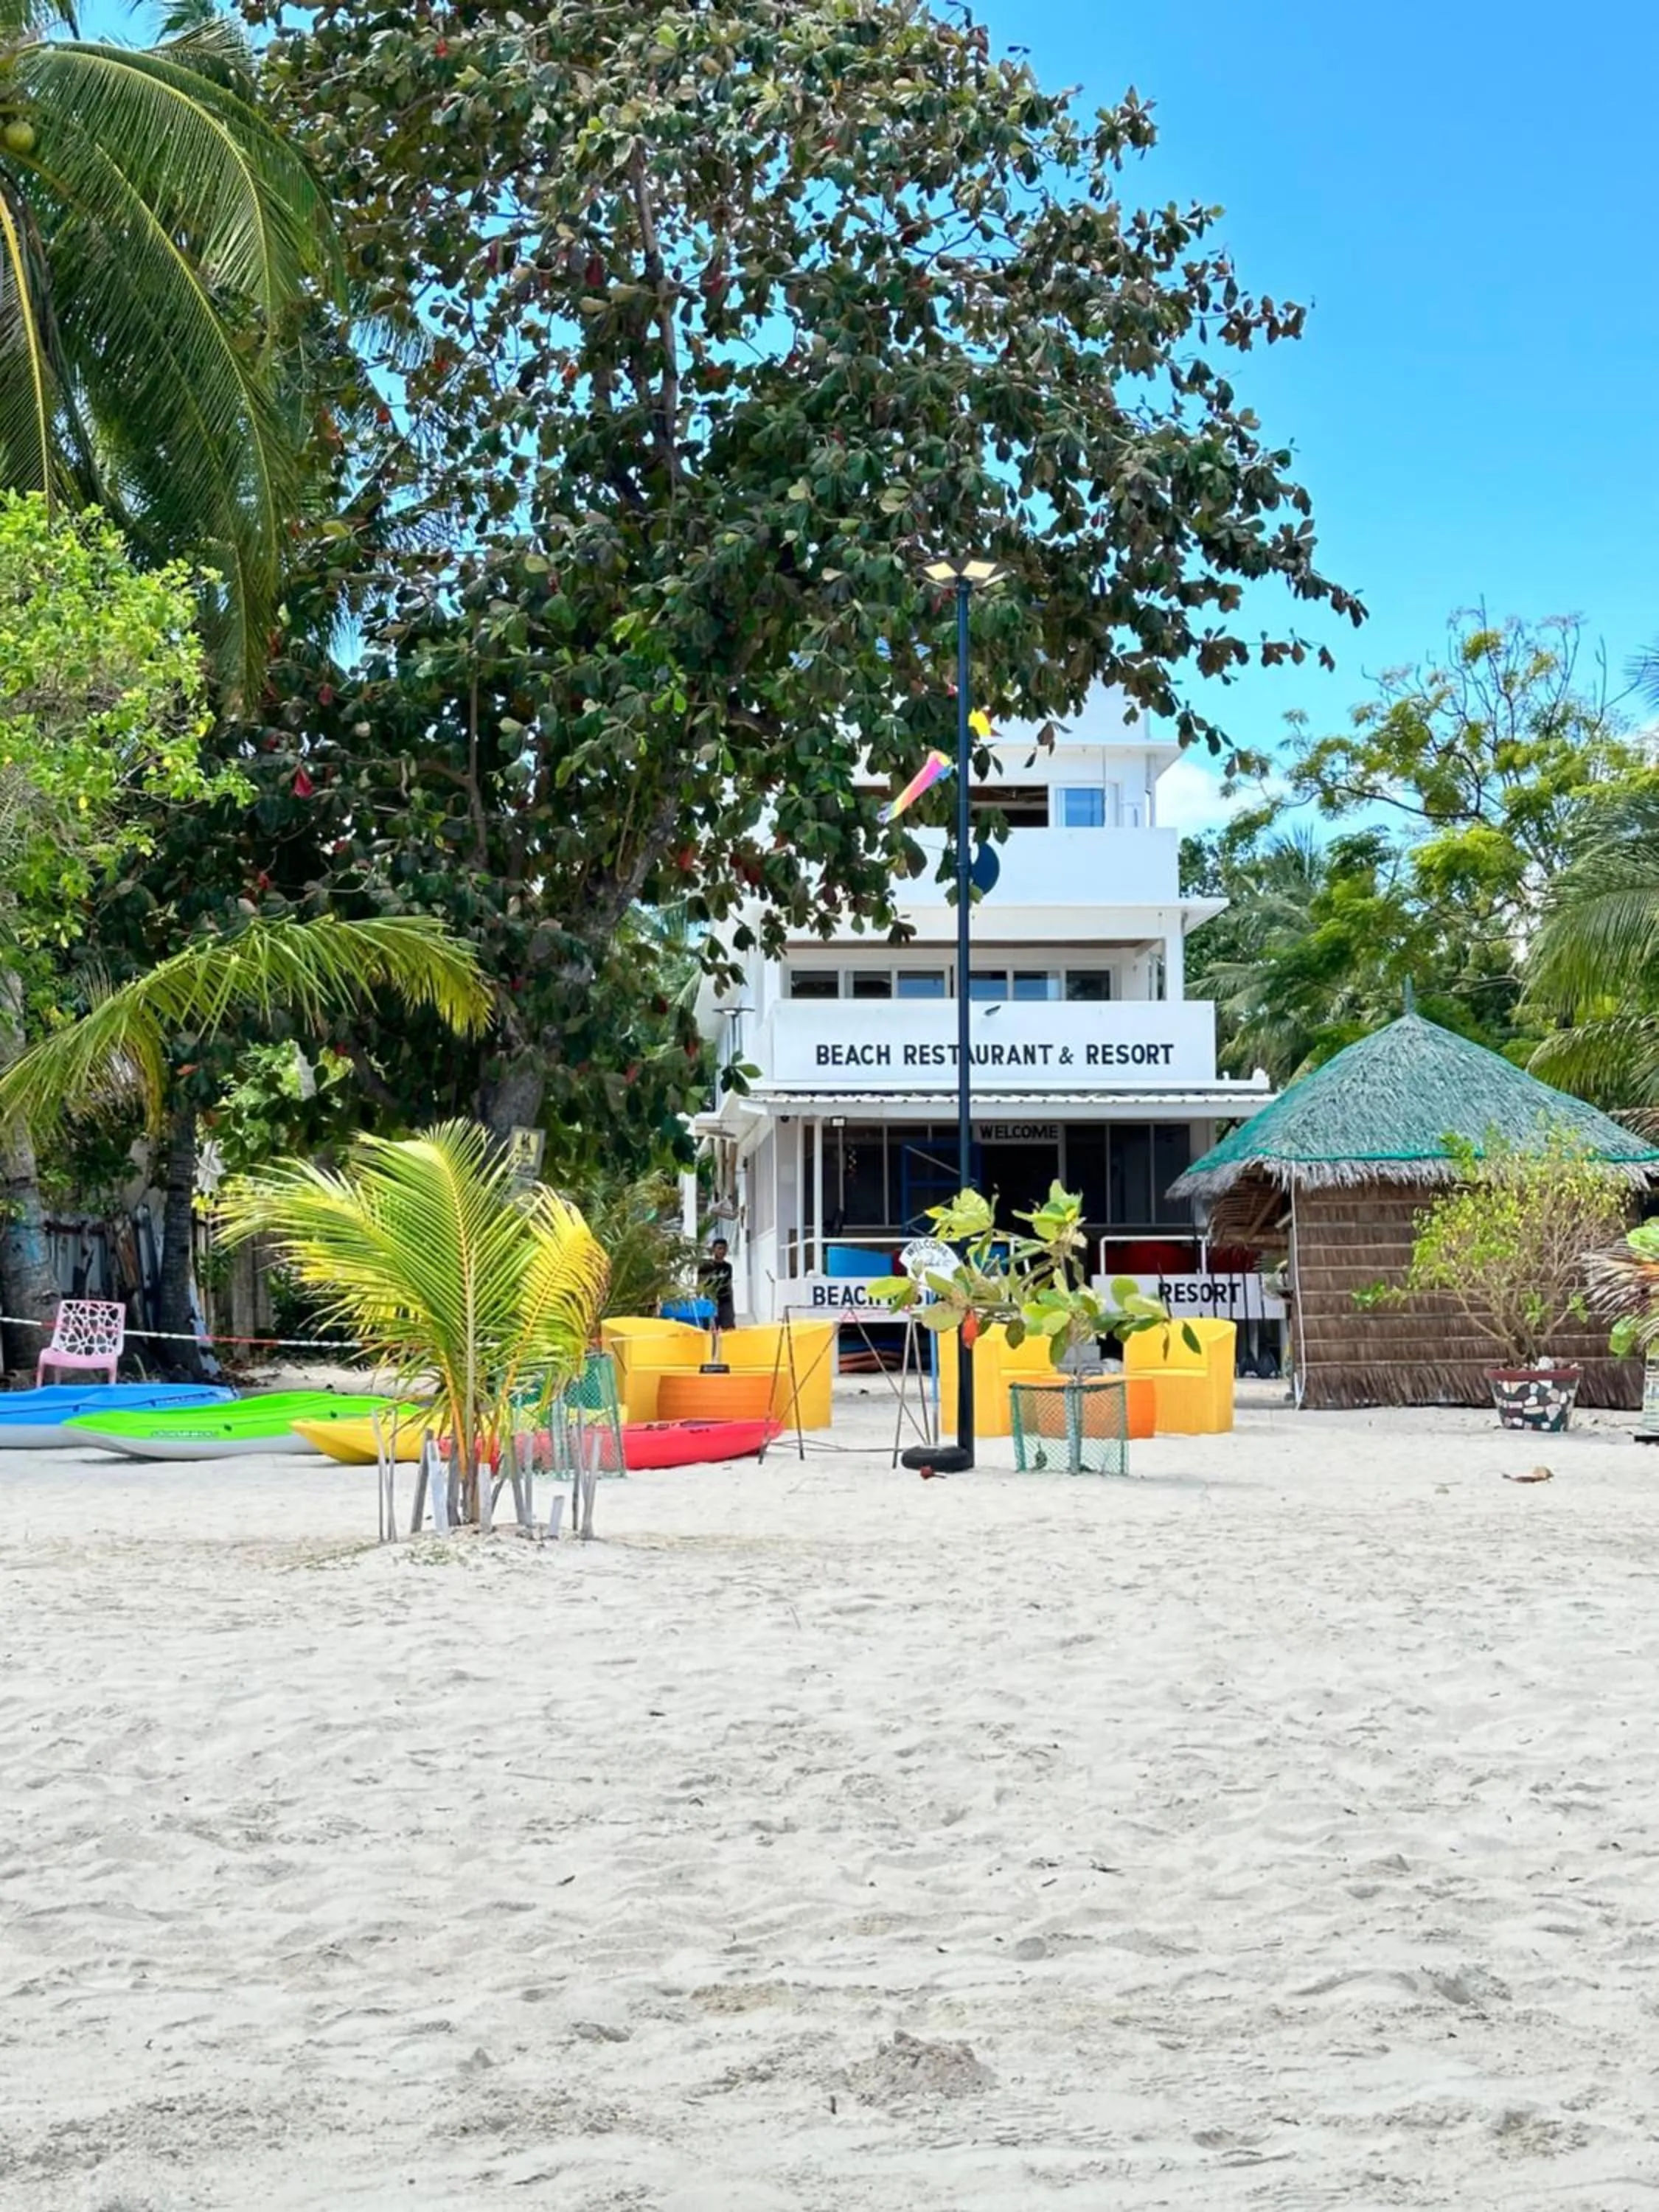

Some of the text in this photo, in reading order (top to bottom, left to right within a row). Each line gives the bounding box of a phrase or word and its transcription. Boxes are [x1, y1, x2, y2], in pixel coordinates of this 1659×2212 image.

[815, 1044, 891, 1065] BEACH
[1058, 1046, 1074, 1065] &
[1086, 1043, 1175, 1065] RESORT
[979, 1124, 1058, 1139] WELCOME
[1158, 1283, 1241, 1303] RESORT
